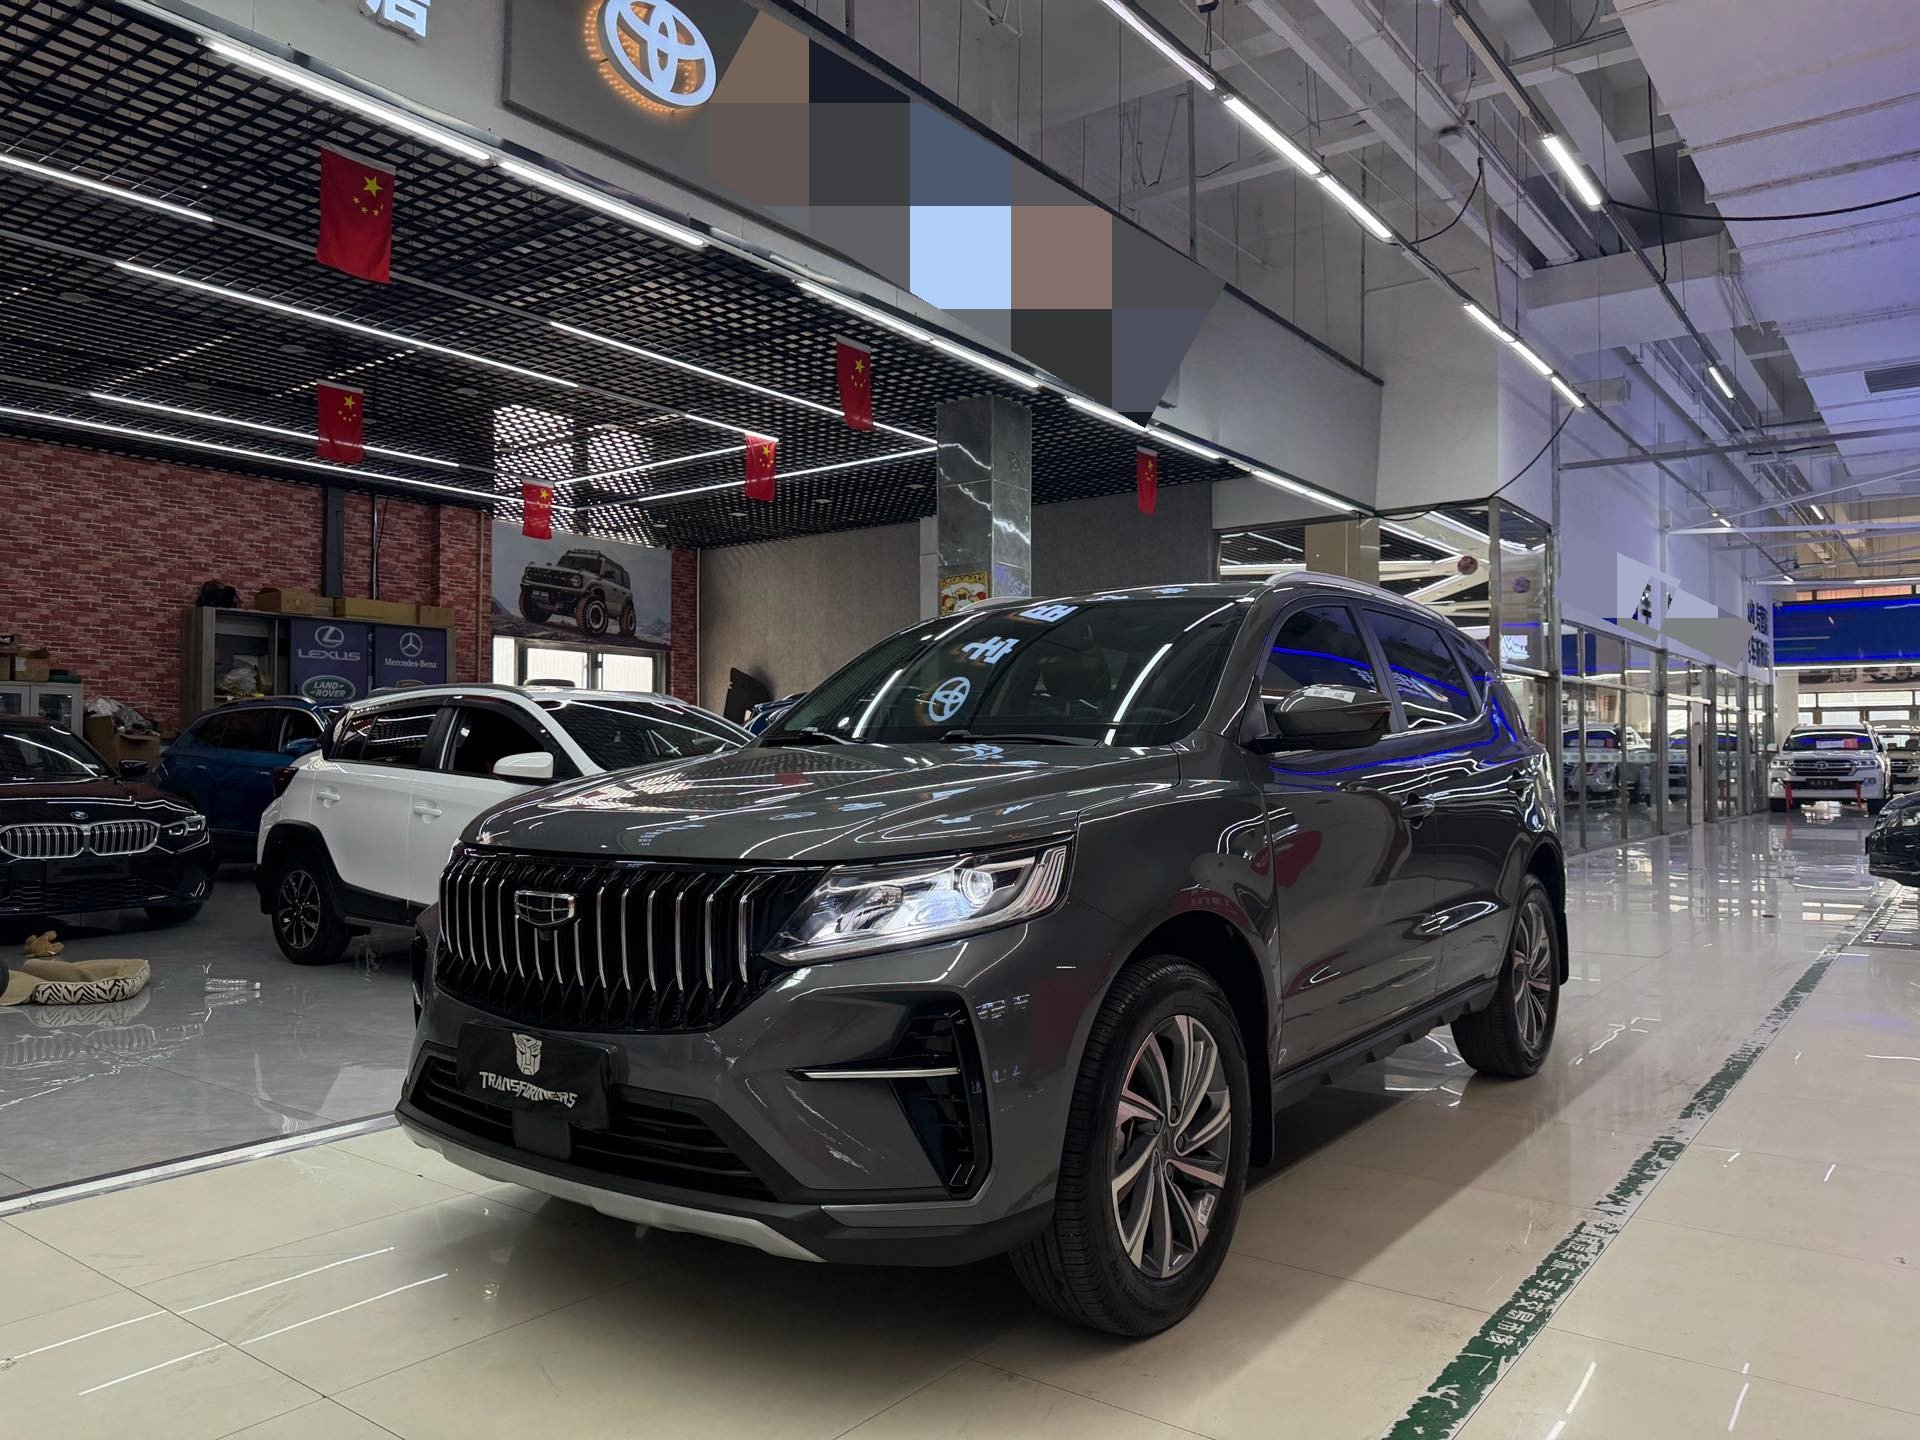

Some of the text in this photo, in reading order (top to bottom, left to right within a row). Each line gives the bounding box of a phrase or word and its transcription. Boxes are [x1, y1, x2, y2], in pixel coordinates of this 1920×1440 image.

[298, 649, 360, 661] LEXUS
[384, 657, 438, 669] Mercedes-Benz
[313, 681, 339, 690] LAND
[315, 689, 346, 697] ROVER
[479, 1071, 578, 1109] TRANSFORMERS
